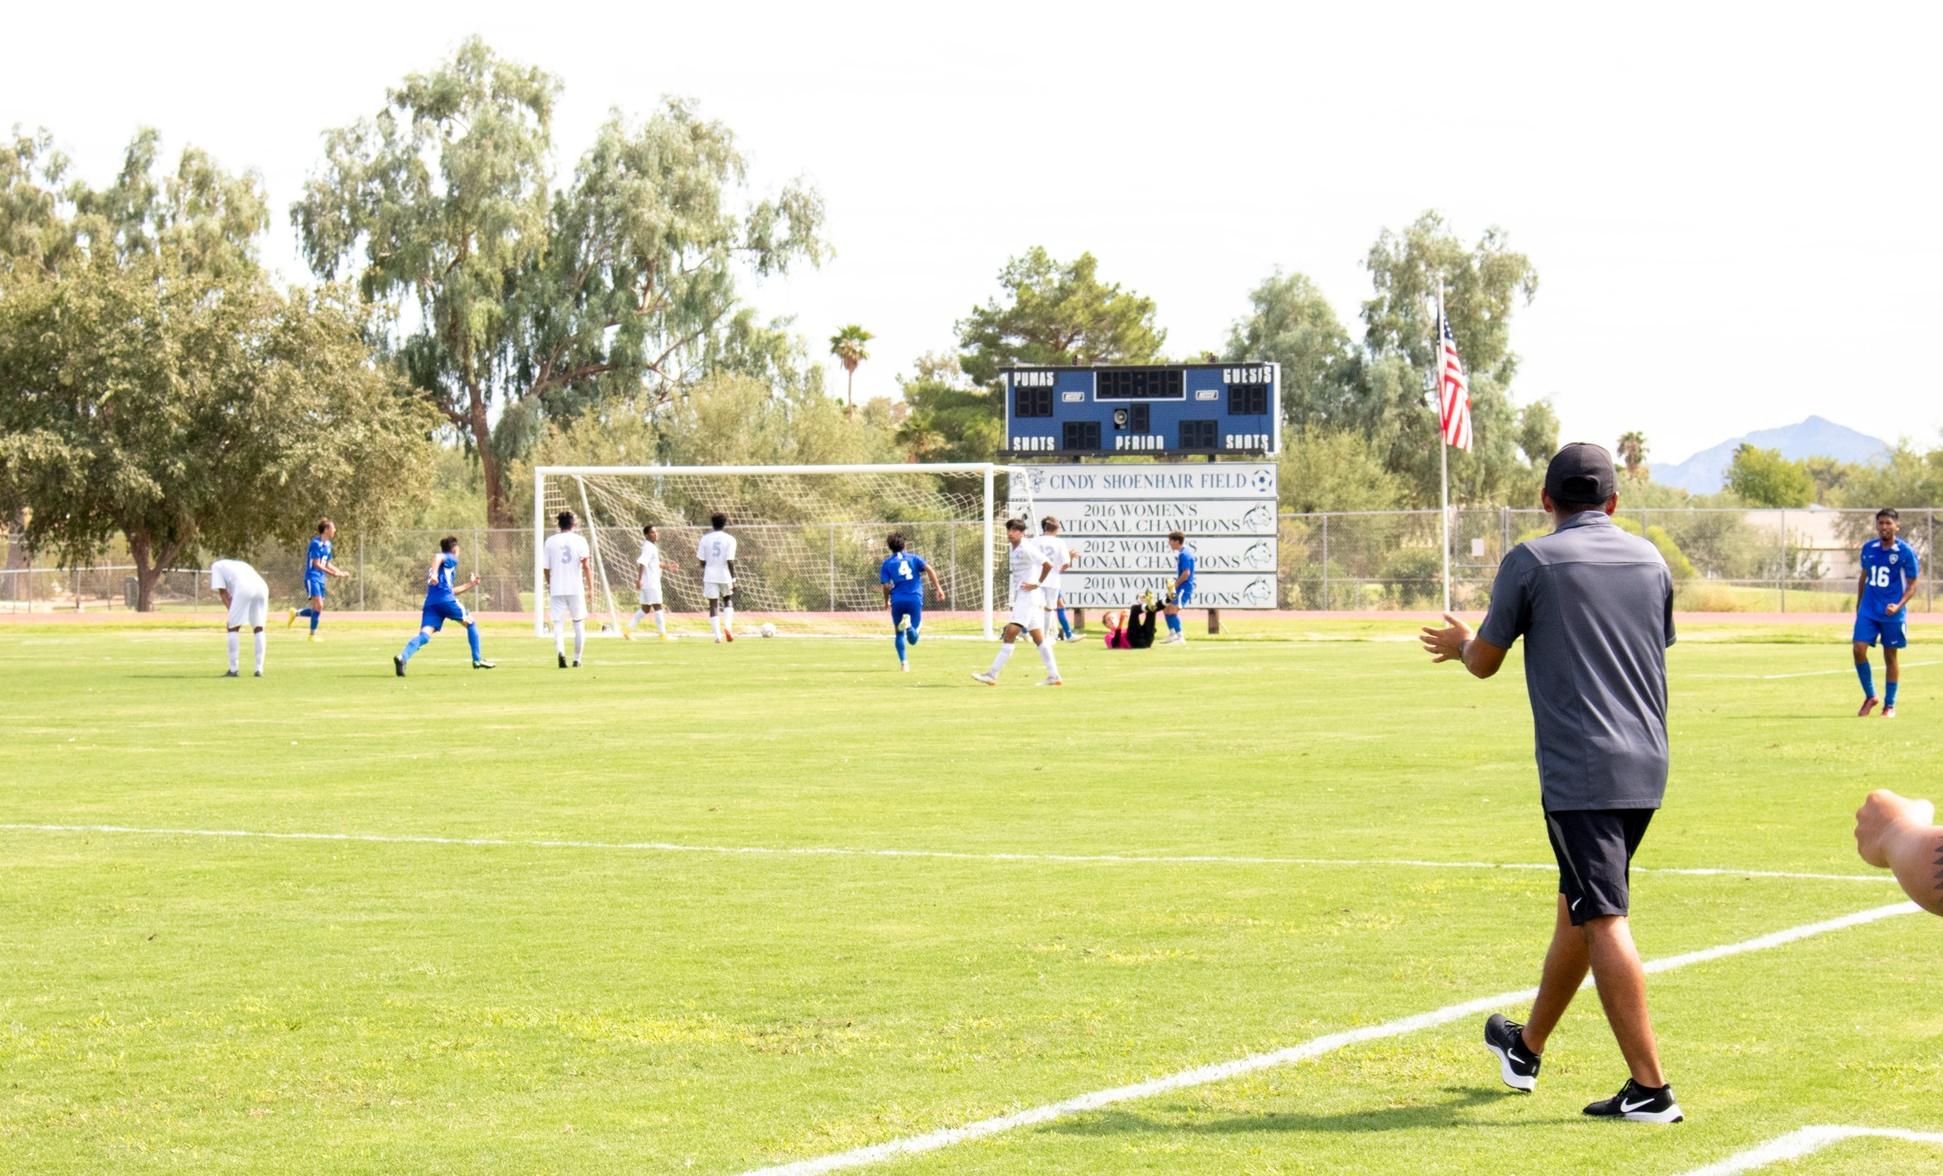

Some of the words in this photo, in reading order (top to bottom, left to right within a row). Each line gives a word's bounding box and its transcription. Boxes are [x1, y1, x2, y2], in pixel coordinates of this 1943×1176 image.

[1013, 371, 1055, 387] PUMAS
[1013, 436, 1055, 451] SHOTS
[1225, 434, 1269, 451] SHOTS
[1049, 474, 1098, 490] CINDY
[1103, 473, 1194, 489] SHOENHAIR
[1200, 473, 1247, 488] FIELD
[1083, 504, 1116, 517] 2016
[1119, 503, 1198, 517] WOMEN'S
[1058, 519, 1132, 533] ATIONAL
[1135, 519, 1241, 533] CHAMPIONS
[560, 545, 572, 564] 3
[712, 541, 722, 558] 5
[1083, 540, 1116, 553] 2012
[1119, 540, 1198, 553] WOME'S
[898, 560, 913, 580] 4
[1869, 565, 1890, 587] 16
[1083, 576, 1116, 590] 2010
